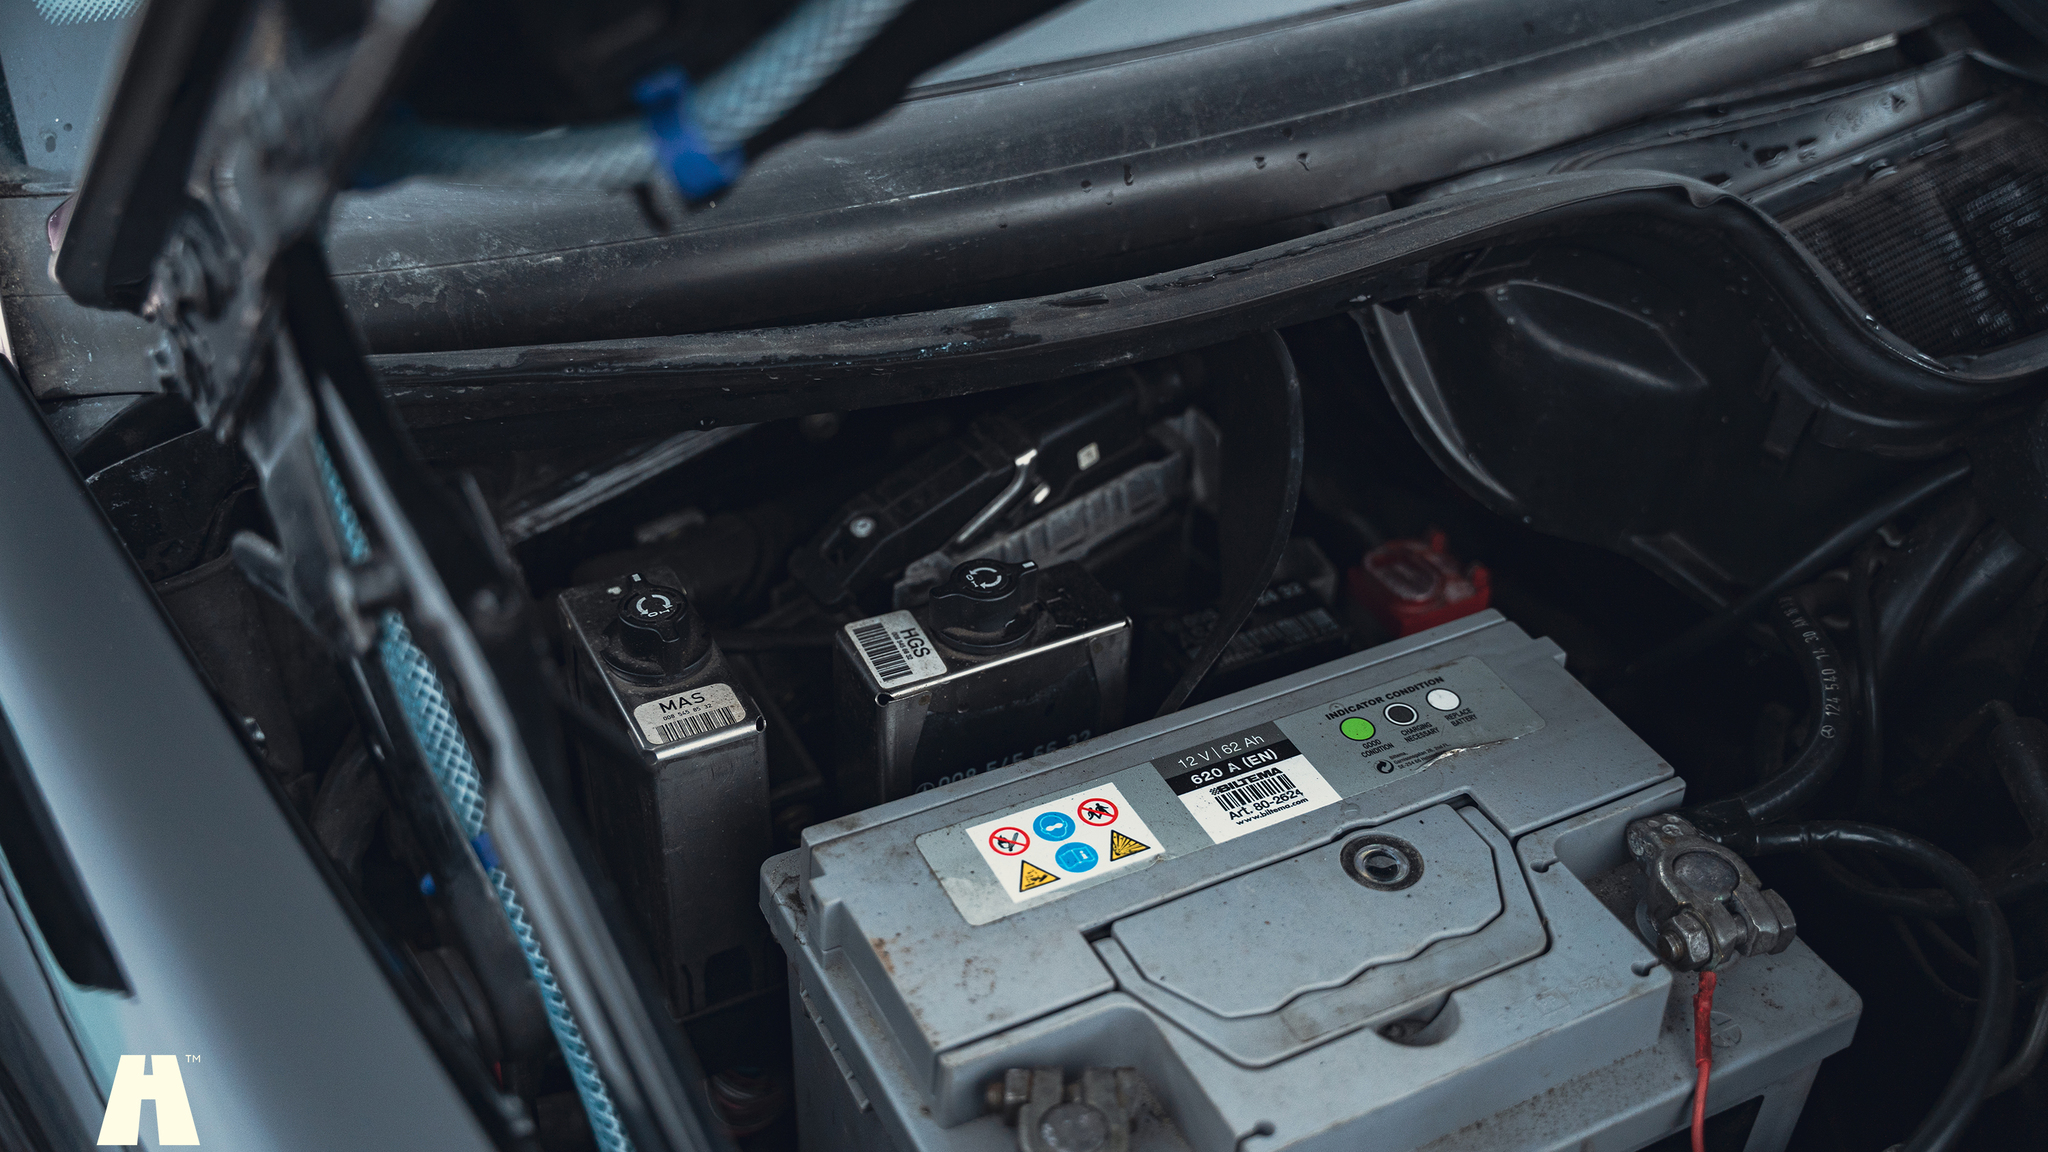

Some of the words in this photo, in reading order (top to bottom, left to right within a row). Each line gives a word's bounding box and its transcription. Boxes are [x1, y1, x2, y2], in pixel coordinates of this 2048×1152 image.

[900, 627, 931, 658] HGS
[1802, 630, 1820, 644] 30
[1822, 668, 1840, 690] 540
[658, 692, 705, 714] MAS
[704, 702, 713, 710] 32
[1324, 696, 1384, 721] INDICATOR
[1385, 676, 1444, 700] CONDITION
[1825, 697, 1840, 716] 124
[1444, 707, 1474, 722] REPLACE
[1450, 714, 1478, 728] BATTERY
[1400, 722, 1432, 736] CHARGING
[1404, 727, 1440, 743] NECESSARY
[1178, 756, 1198, 768] 12
[1198, 752, 1210, 762] V
[1222, 742, 1242, 754] 62
[1244, 734, 1265, 748] Ah
[1361, 742, 1394, 758] CONDITION
[1362, 738, 1382, 750] GOOD
[1190, 768, 1224, 785] 620
[1228, 762, 1242, 773] A
[1242, 748, 1278, 768] (EN)
[1216, 767, 1283, 793] BILTEMA
[1228, 805, 1254, 820] Art.
[1254, 788, 1304, 811] 80-2624
[1236, 797, 1309, 826] www.biltema.com
